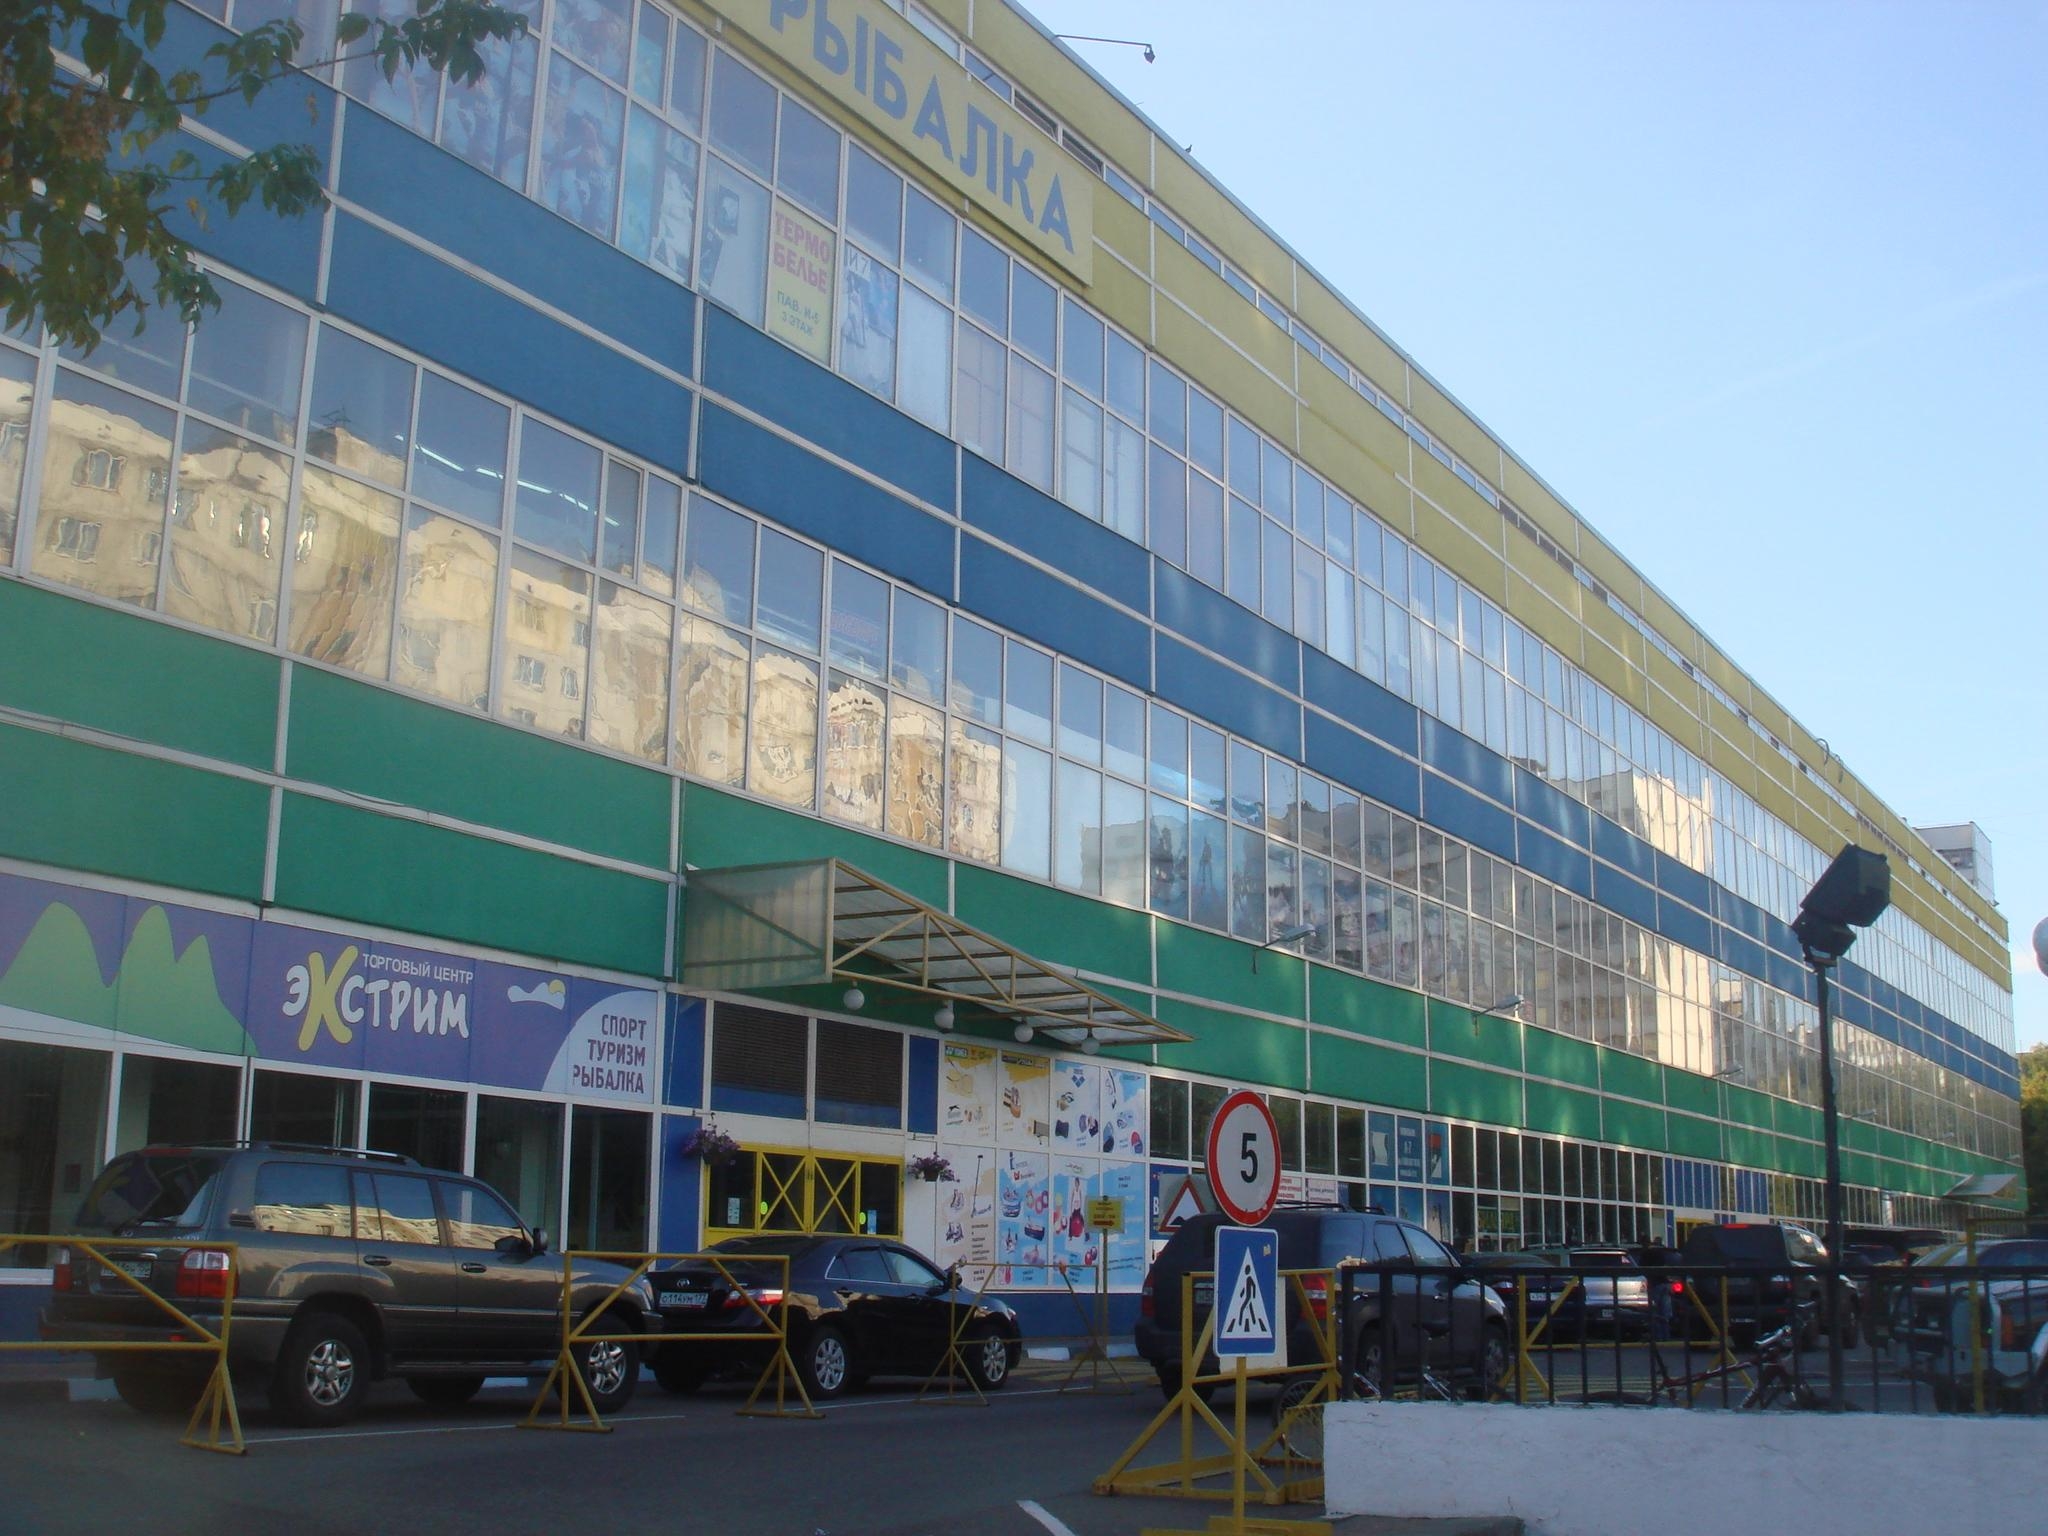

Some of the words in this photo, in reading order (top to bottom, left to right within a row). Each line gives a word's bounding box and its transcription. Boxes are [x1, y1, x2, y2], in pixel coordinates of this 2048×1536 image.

[775, 211, 831, 265] ТЕРМО
[773, 243, 828, 295] БЕЛЬЕ
[363, 953, 431, 977] ТОРГОВЫЙ
[434, 967, 474, 985] ЦЕНТР
[601, 1014, 647, 1041] СПОРТ
[588, 1039, 646, 1067] ТУРИЗМ
[573, 1064, 645, 1094] РЫБАЛКА
[1240, 1132, 1258, 1183] 5
